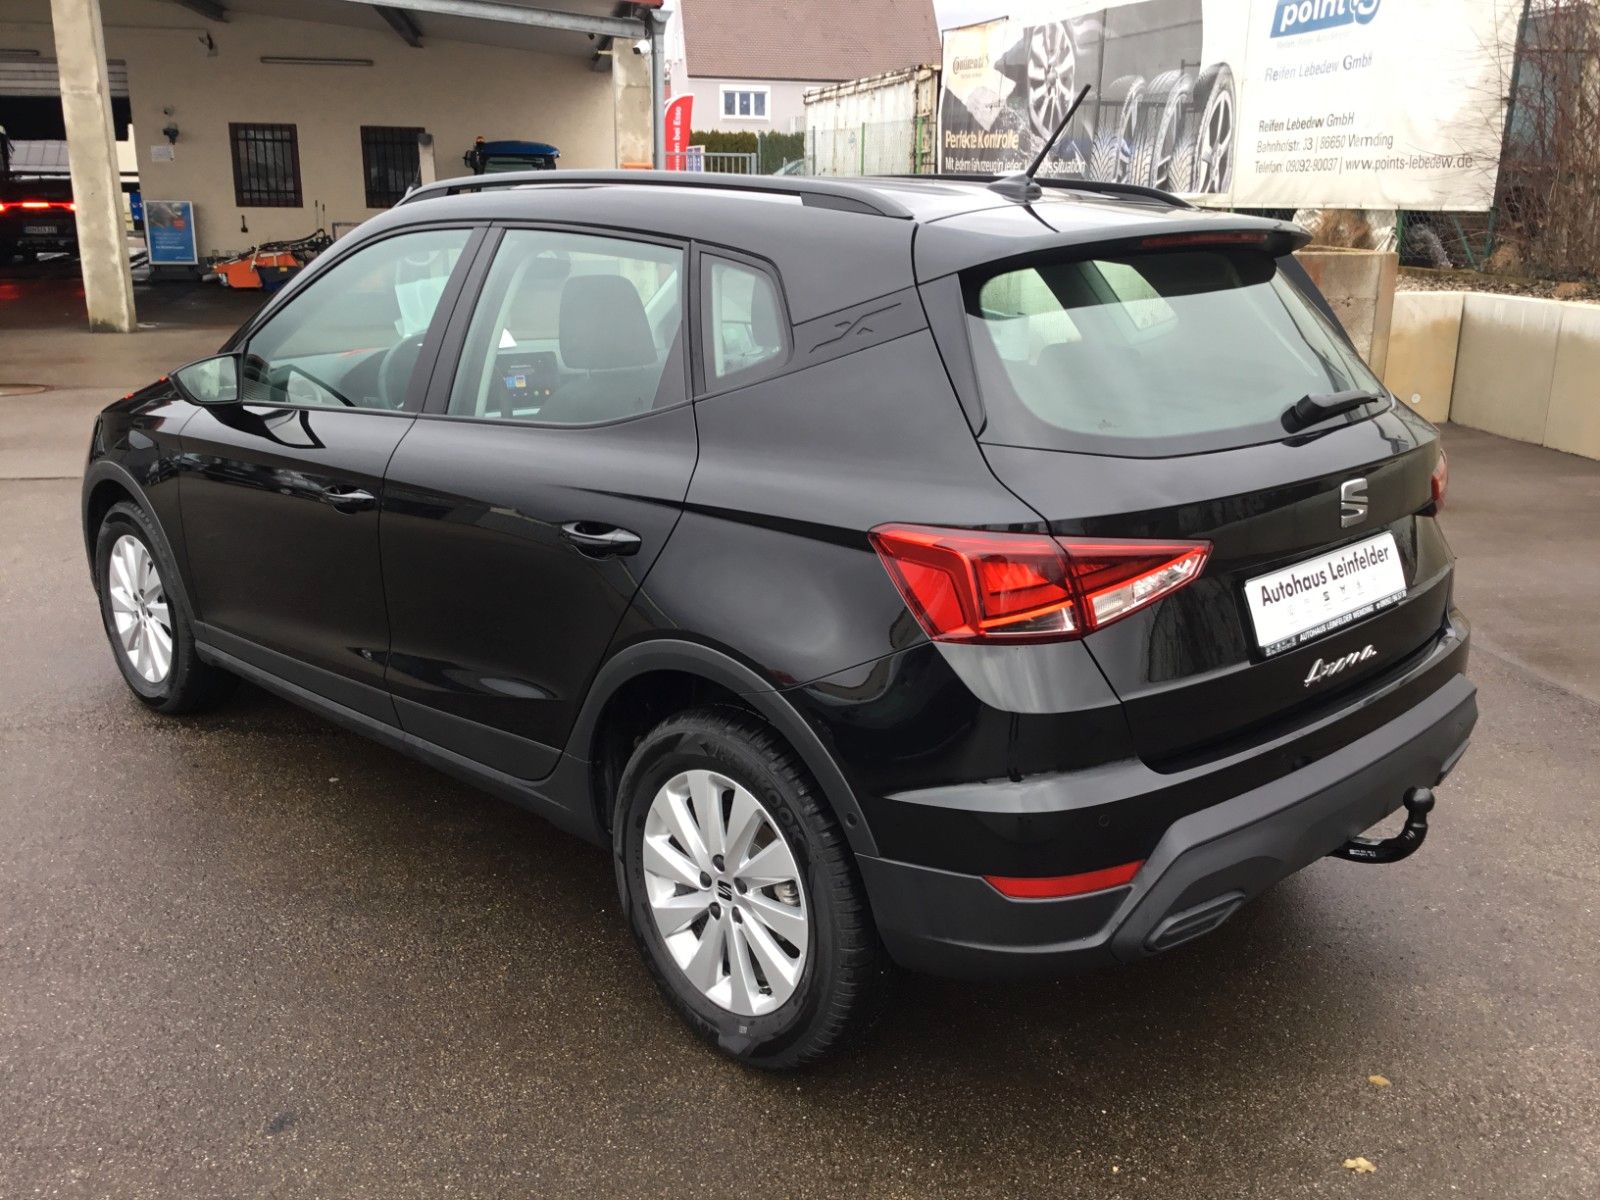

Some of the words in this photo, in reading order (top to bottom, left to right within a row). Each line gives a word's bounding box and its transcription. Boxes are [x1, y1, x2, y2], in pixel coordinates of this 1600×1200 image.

[1264, 66, 1296, 82] Reifen
[1298, 59, 1339, 78] Lebedew
[672, 106, 682, 126] Esso
[1258, 119, 1285, 133] Reifen
[1286, 116, 1324, 131] Lebedew
[1326, 112, 1355, 128] GmbH
[945, 129, 977, 149] Perfekte
[977, 129, 1019, 150] Kontrolle
[1260, 569, 1327, 607] Autohaus
[1327, 545, 1389, 581] Leinfelder
[1299, 625, 1327, 642] AUTOHAUS
